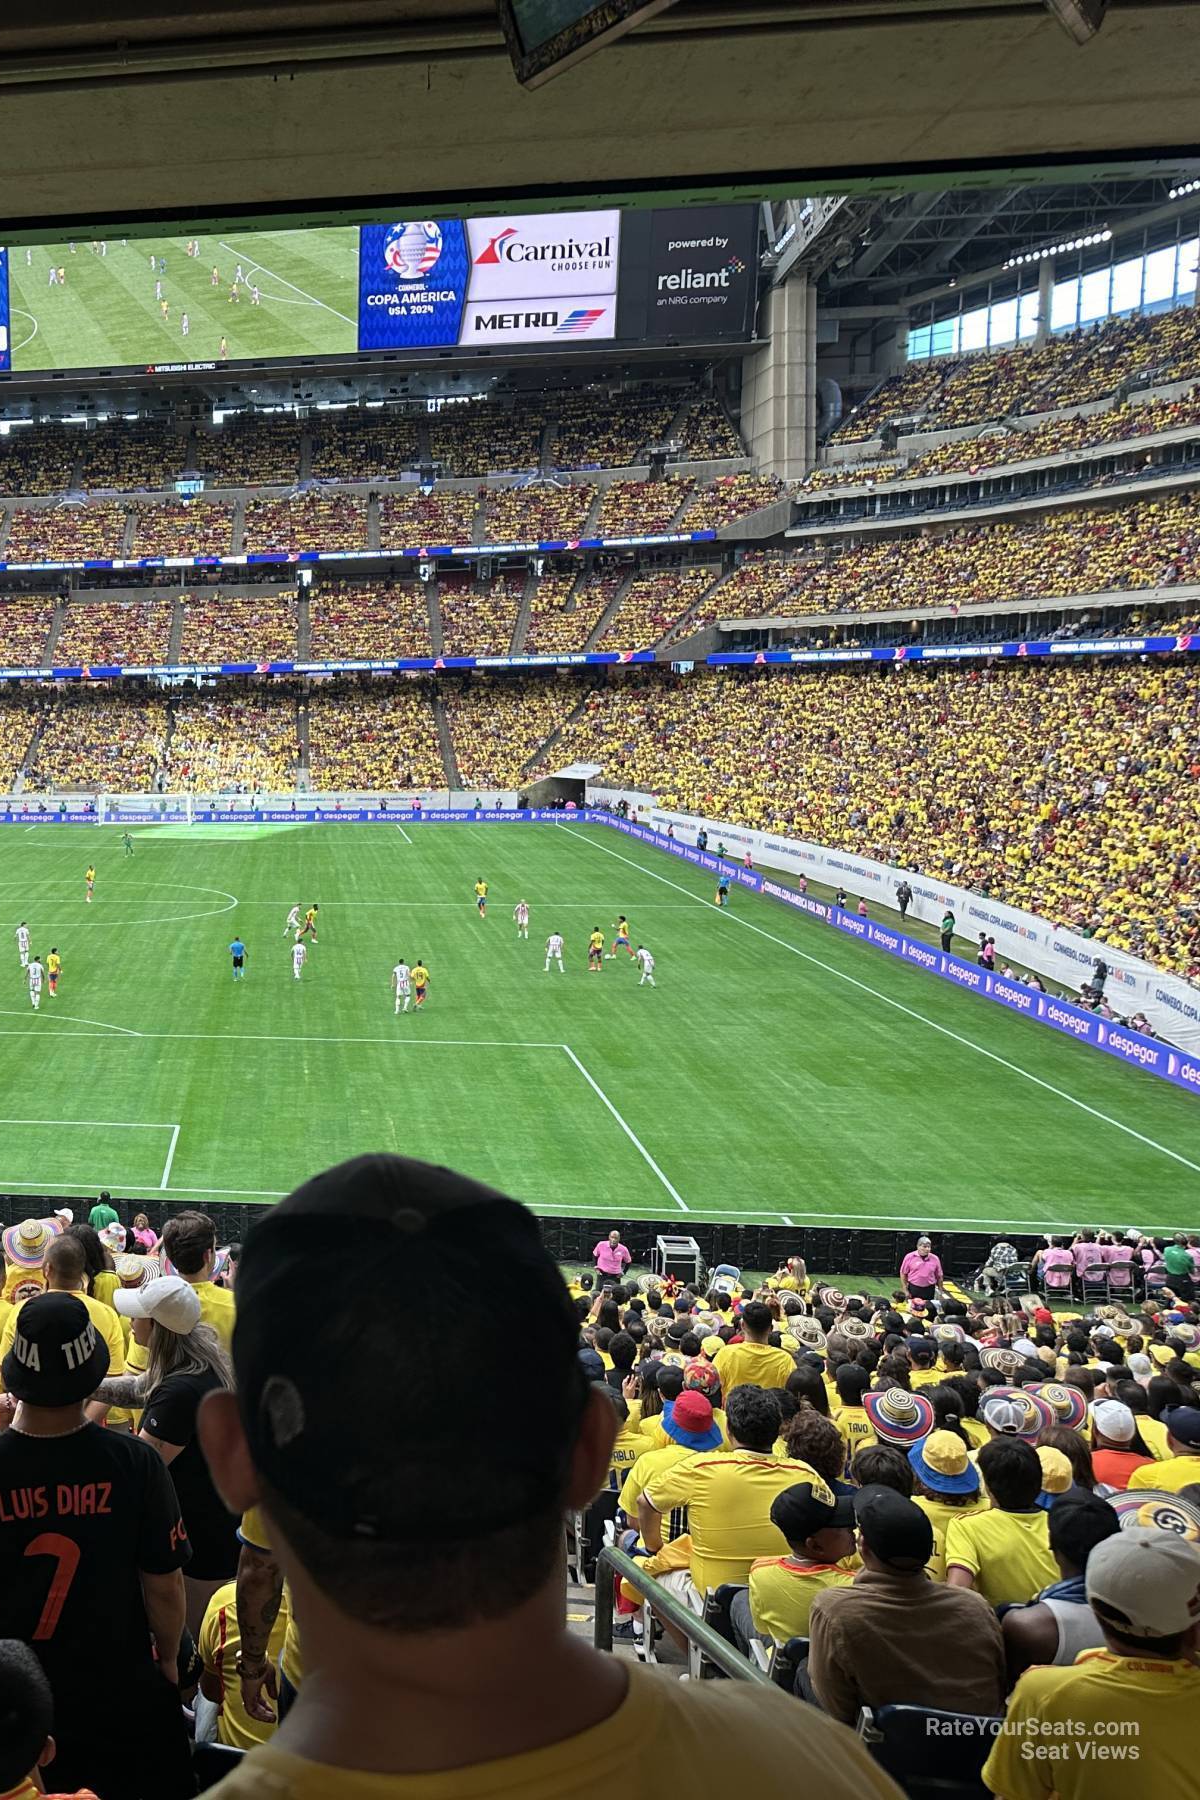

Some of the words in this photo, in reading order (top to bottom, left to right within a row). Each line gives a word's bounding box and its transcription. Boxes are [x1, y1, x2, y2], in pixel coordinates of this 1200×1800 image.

[506, 236, 611, 262] Carnival
[668, 237, 712, 251] powered
[714, 235, 728, 249] by
[551, 261, 589, 272] CHOOSE
[591, 259, 611, 270] FUN
[657, 267, 730, 290] reliant
[366, 294, 400, 306] COPA
[401, 291, 456, 304] AMERICA
[656, 298, 667, 306] an
[667, 295, 687, 305] NRG
[688, 294, 728, 306] company
[388, 305, 408, 316] USA
[410, 304, 434, 315] 2024
[475, 310, 559, 331] METRO
[20, 814, 54, 823] despegar
[220, 813, 256, 822] despegar
[270, 813, 308, 822] despegar
[323, 812, 361, 821] despegar
[376, 812, 414, 821] despegar
[430, 811, 469, 820] despegar
[485, 811, 524, 820] despegar
[540, 811, 579, 820] despegar
[842, 914, 865, 934] despegar
[874, 928, 899, 950] despegar
[908, 943, 937, 966] despegar
[1053, 942, 1078, 961] CONMEBOL
[948, 962, 981, 985] despegar
[994, 981, 1031, 1008] despegar
[1155, 989, 1182, 1014] CONMEBOL
[1183, 1002, 1199, 1020] COPA
[1048, 1005, 1091, 1034] despegar
[1108, 1031, 1159, 1064] despegar
[847, 1422, 869, 1434] TAVO
[57, 1482, 112, 1516] DIAZ
[23, 1532, 81, 1641] 7
